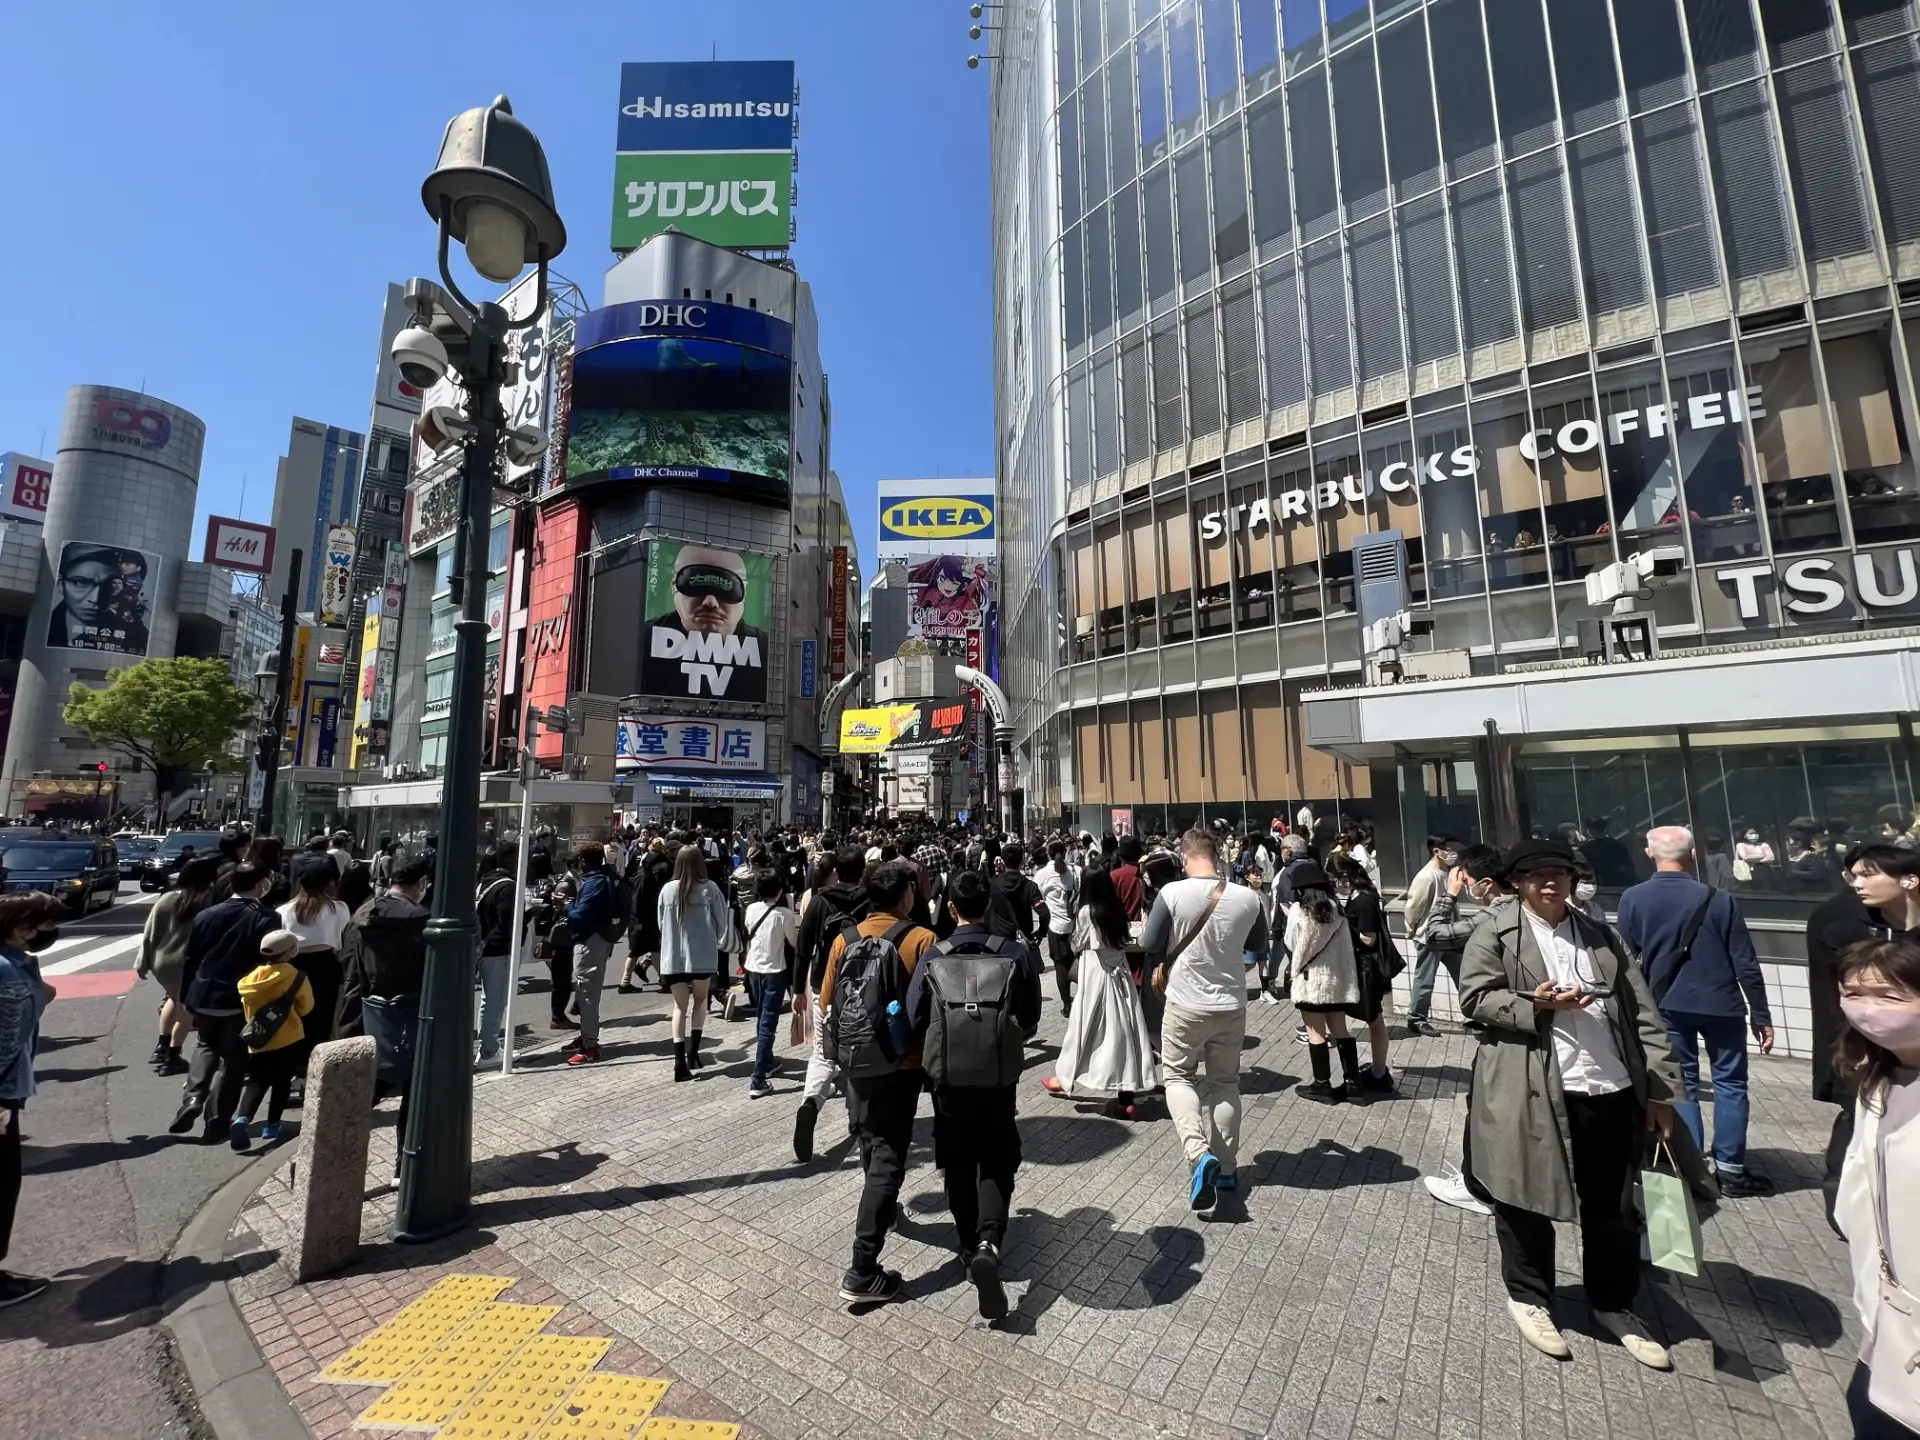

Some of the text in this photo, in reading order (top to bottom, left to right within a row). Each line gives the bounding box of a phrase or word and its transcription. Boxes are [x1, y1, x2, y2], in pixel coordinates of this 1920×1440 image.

[622, 97, 789, 117] Hisamitsu
[625, 180, 778, 217] サロンパス
[639, 305, 706, 328] DHC
[634, 467, 699, 478] DHC Channel
[1202, 385, 1767, 540] STARBUCKS COFFEE
[892, 507, 985, 527] IKEA
[224, 536, 259, 556] H&M
[1717, 549, 1919, 618] TSU
[651, 625, 762, 668] DMM
[680, 662, 734, 696] TV
